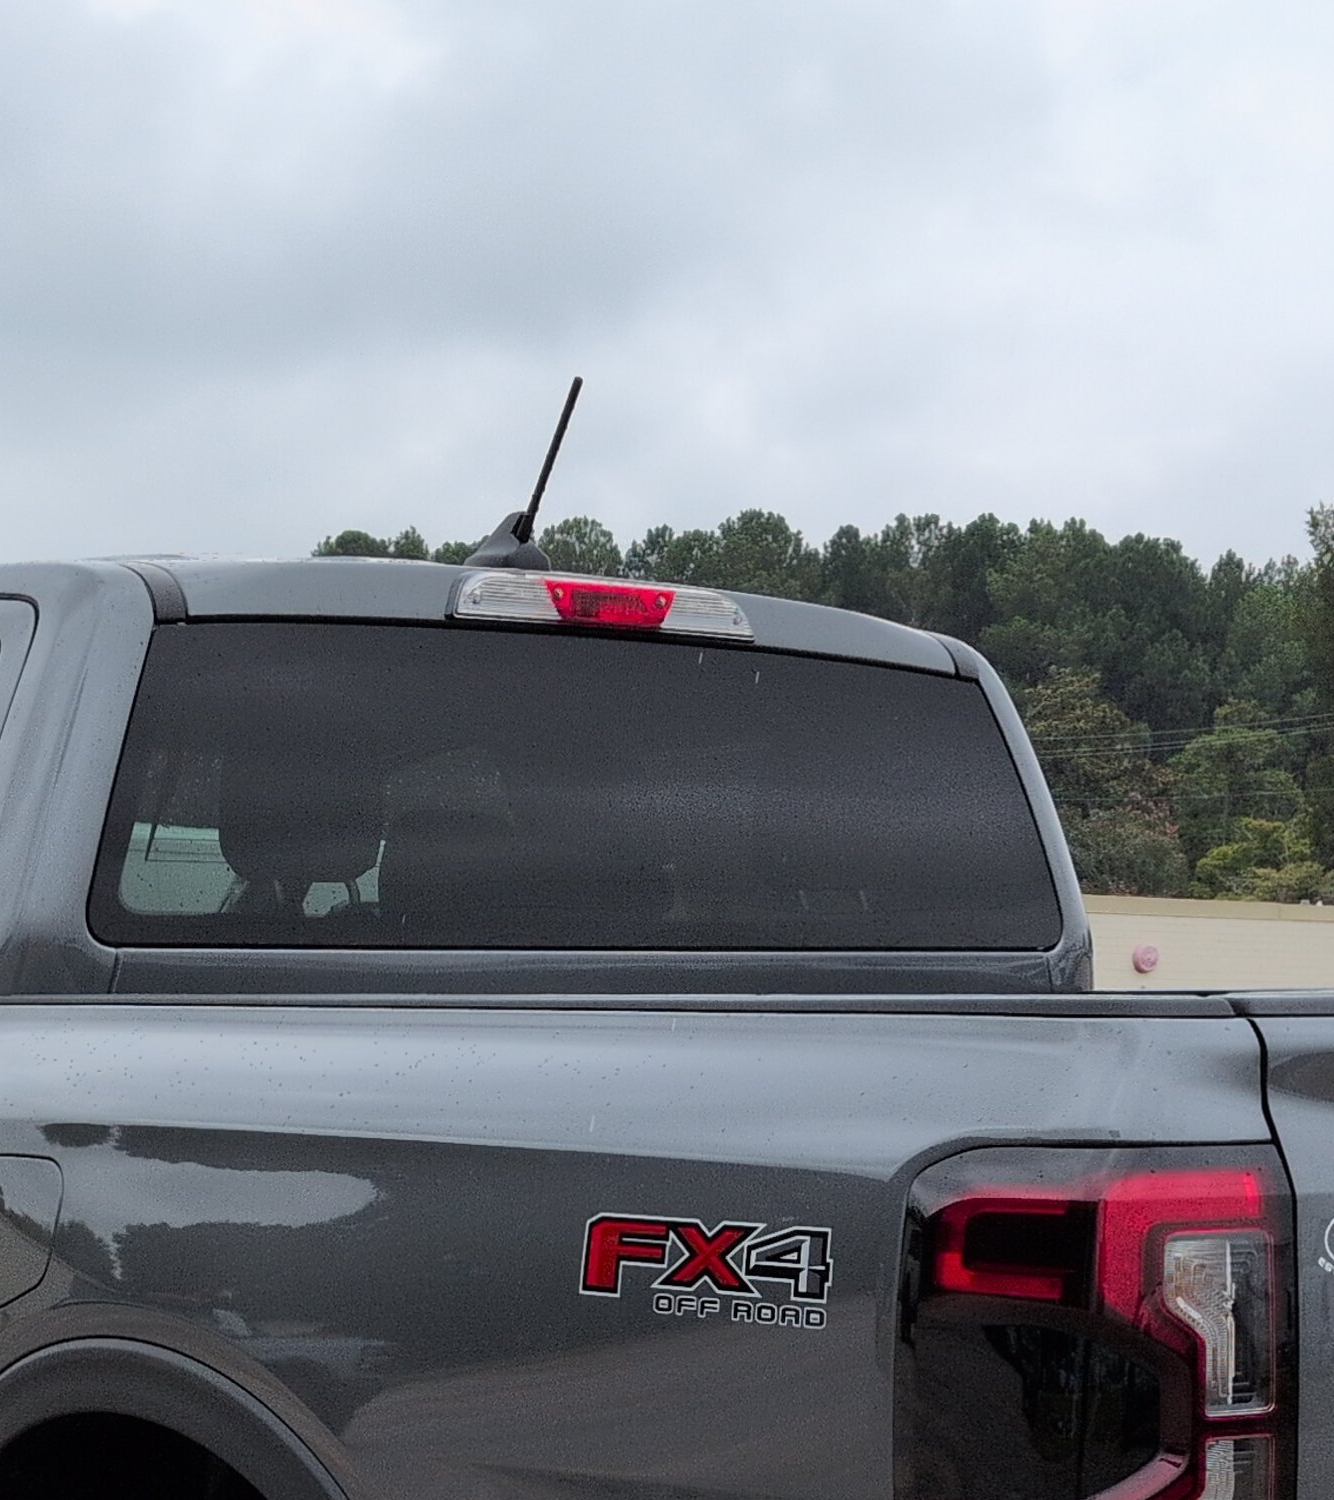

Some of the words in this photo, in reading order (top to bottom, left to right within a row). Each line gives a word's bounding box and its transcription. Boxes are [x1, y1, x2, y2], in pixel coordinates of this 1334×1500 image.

[579, 1212, 833, 1304] FX4
[653, 1293, 720, 1318] OFF
[731, 1300, 827, 1330] ROAD
